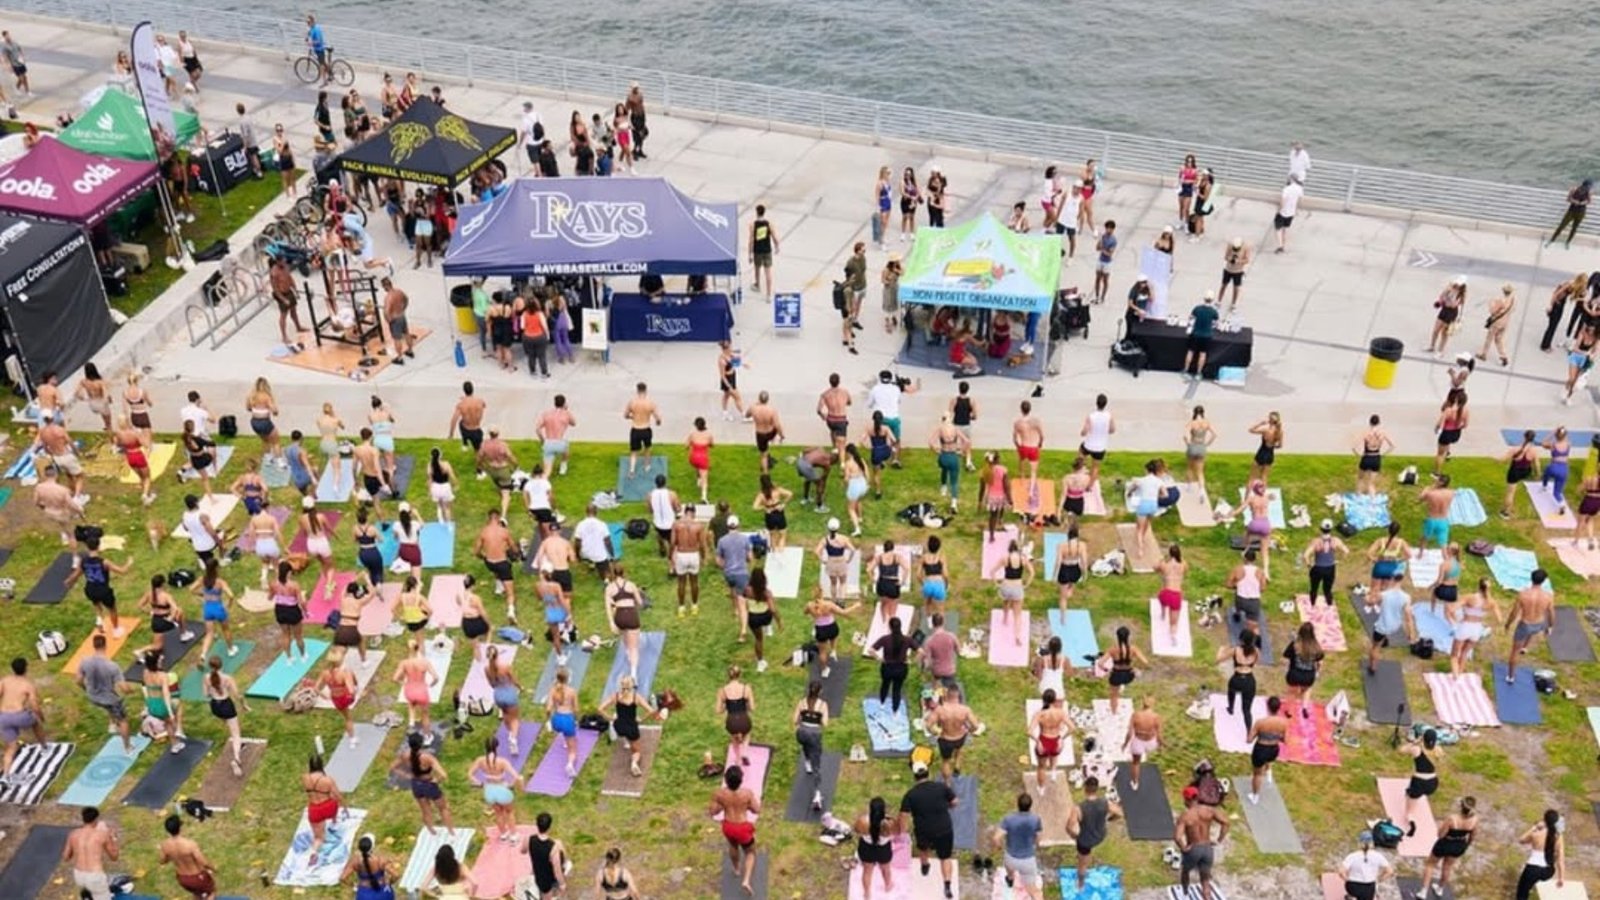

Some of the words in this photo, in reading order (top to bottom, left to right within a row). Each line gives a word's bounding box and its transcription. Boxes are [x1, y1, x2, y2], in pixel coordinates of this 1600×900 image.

[342, 160, 365, 172] PACK
[367, 164, 398, 177] ANIMAL
[400, 170, 449, 185] EVOLUTION
[530, 191, 648, 247] RAYS
[533, 263, 648, 274] RAYSBASEBALL.COM
[968, 291, 1037, 307] ORGANIZATION
[645, 313, 691, 337] RAYS
